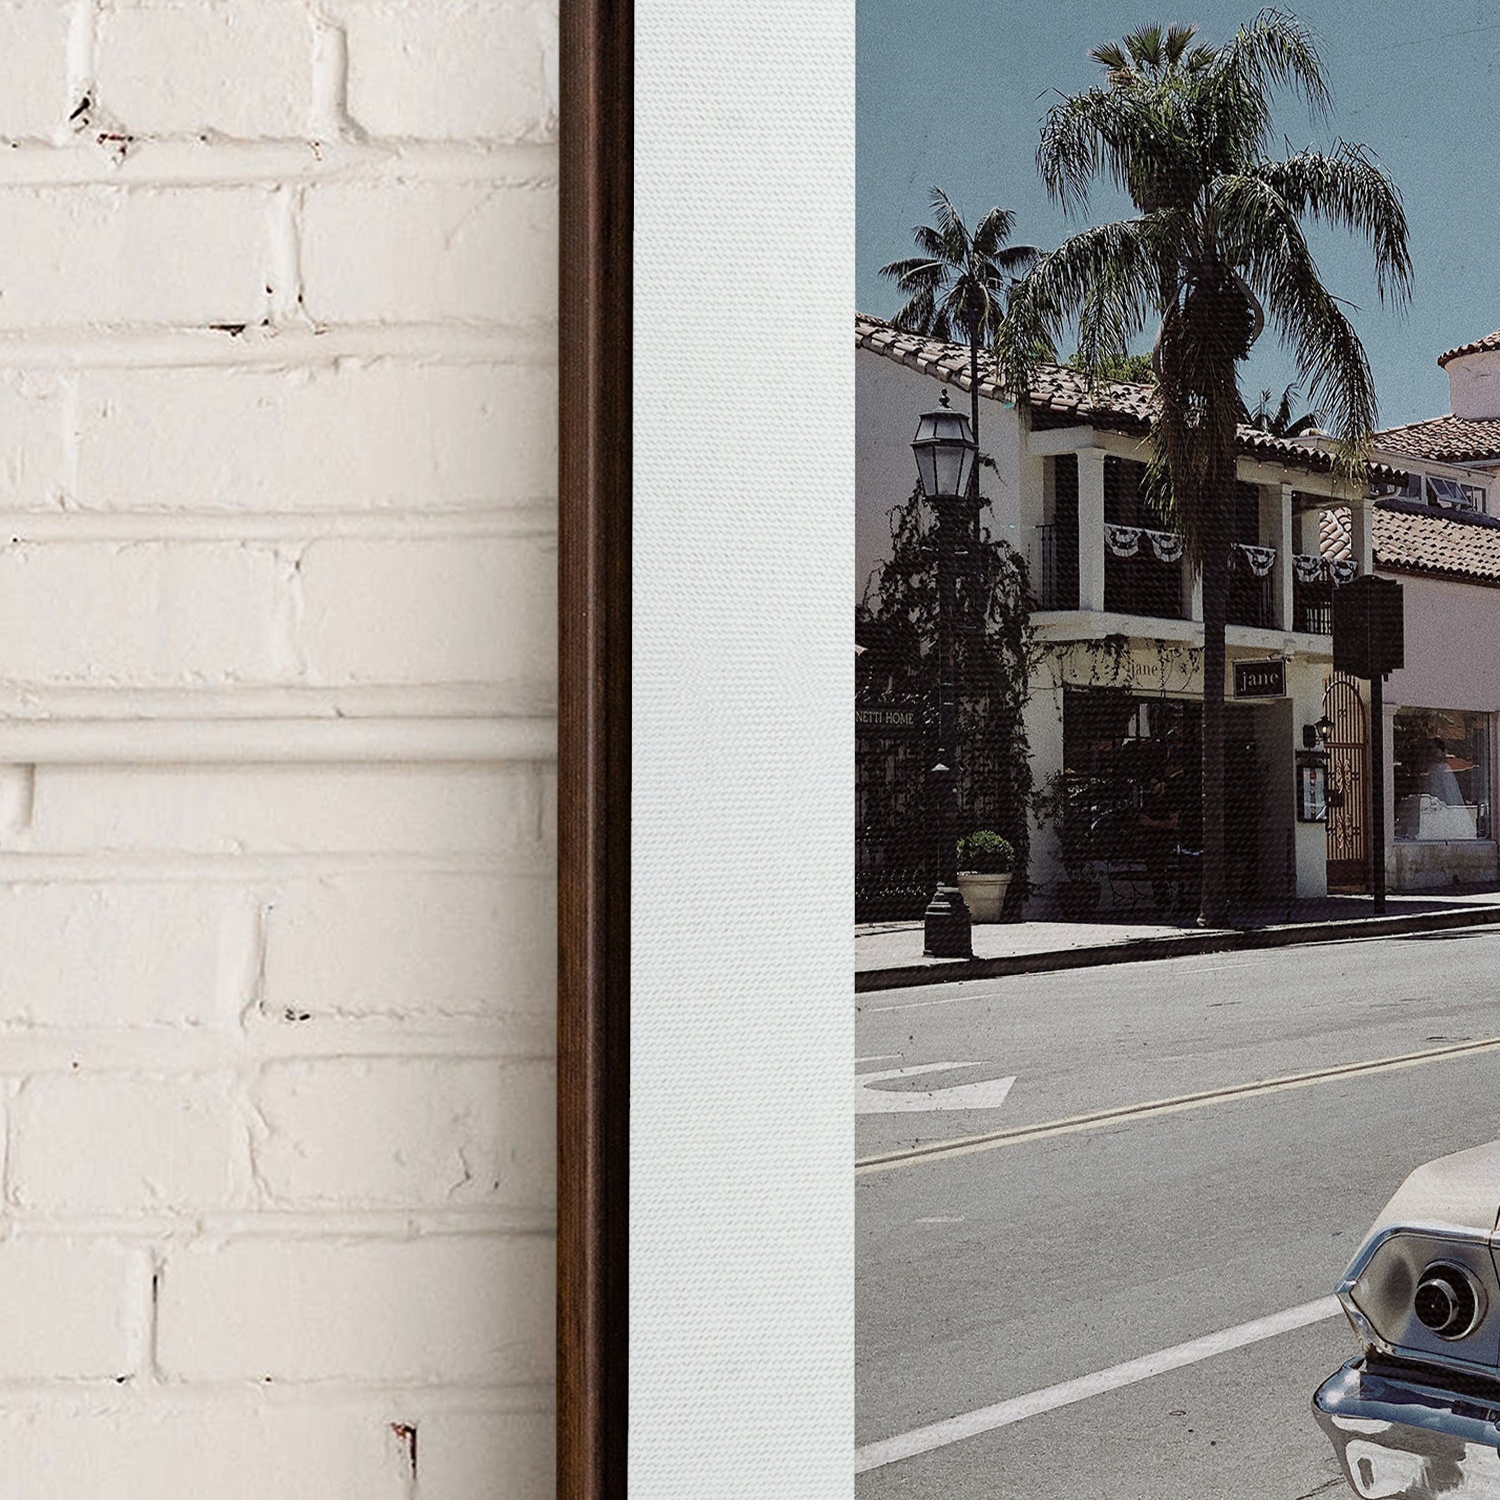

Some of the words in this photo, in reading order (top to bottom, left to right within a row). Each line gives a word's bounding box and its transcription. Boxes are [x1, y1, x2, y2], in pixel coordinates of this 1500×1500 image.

[1131, 659, 1158, 678] jane
[1240, 671, 1279, 692] jane
[885, 711, 914, 725] HOME
